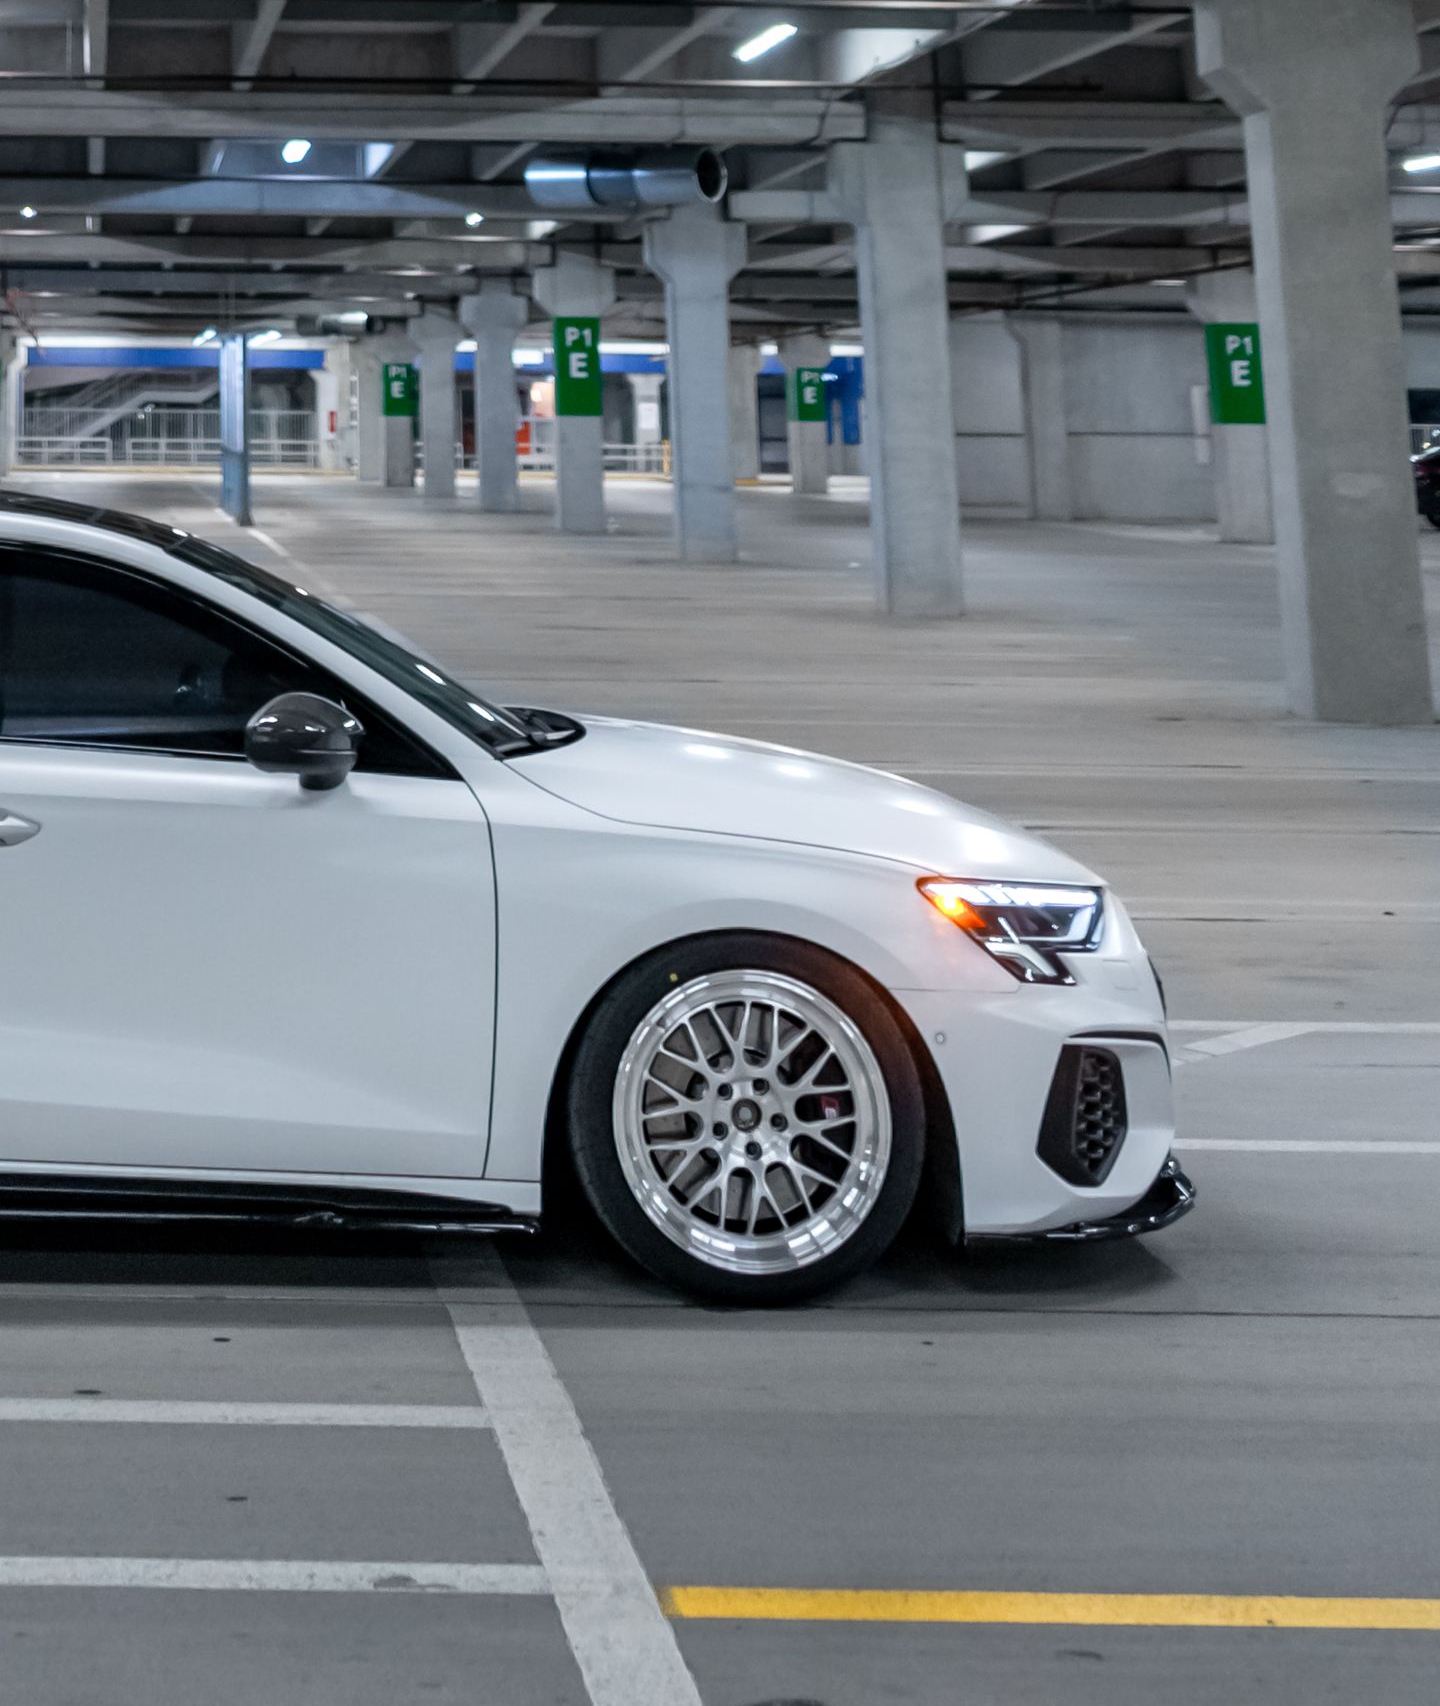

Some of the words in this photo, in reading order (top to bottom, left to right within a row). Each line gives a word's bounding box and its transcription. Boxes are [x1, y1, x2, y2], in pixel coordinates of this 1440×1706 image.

[565, 326, 592, 348] P1
[1225, 334, 1253, 355] P1
[569, 352, 589, 378] E
[1230, 360, 1251, 386] E
[391, 380, 405, 398] E
[803, 387, 817, 404] E
